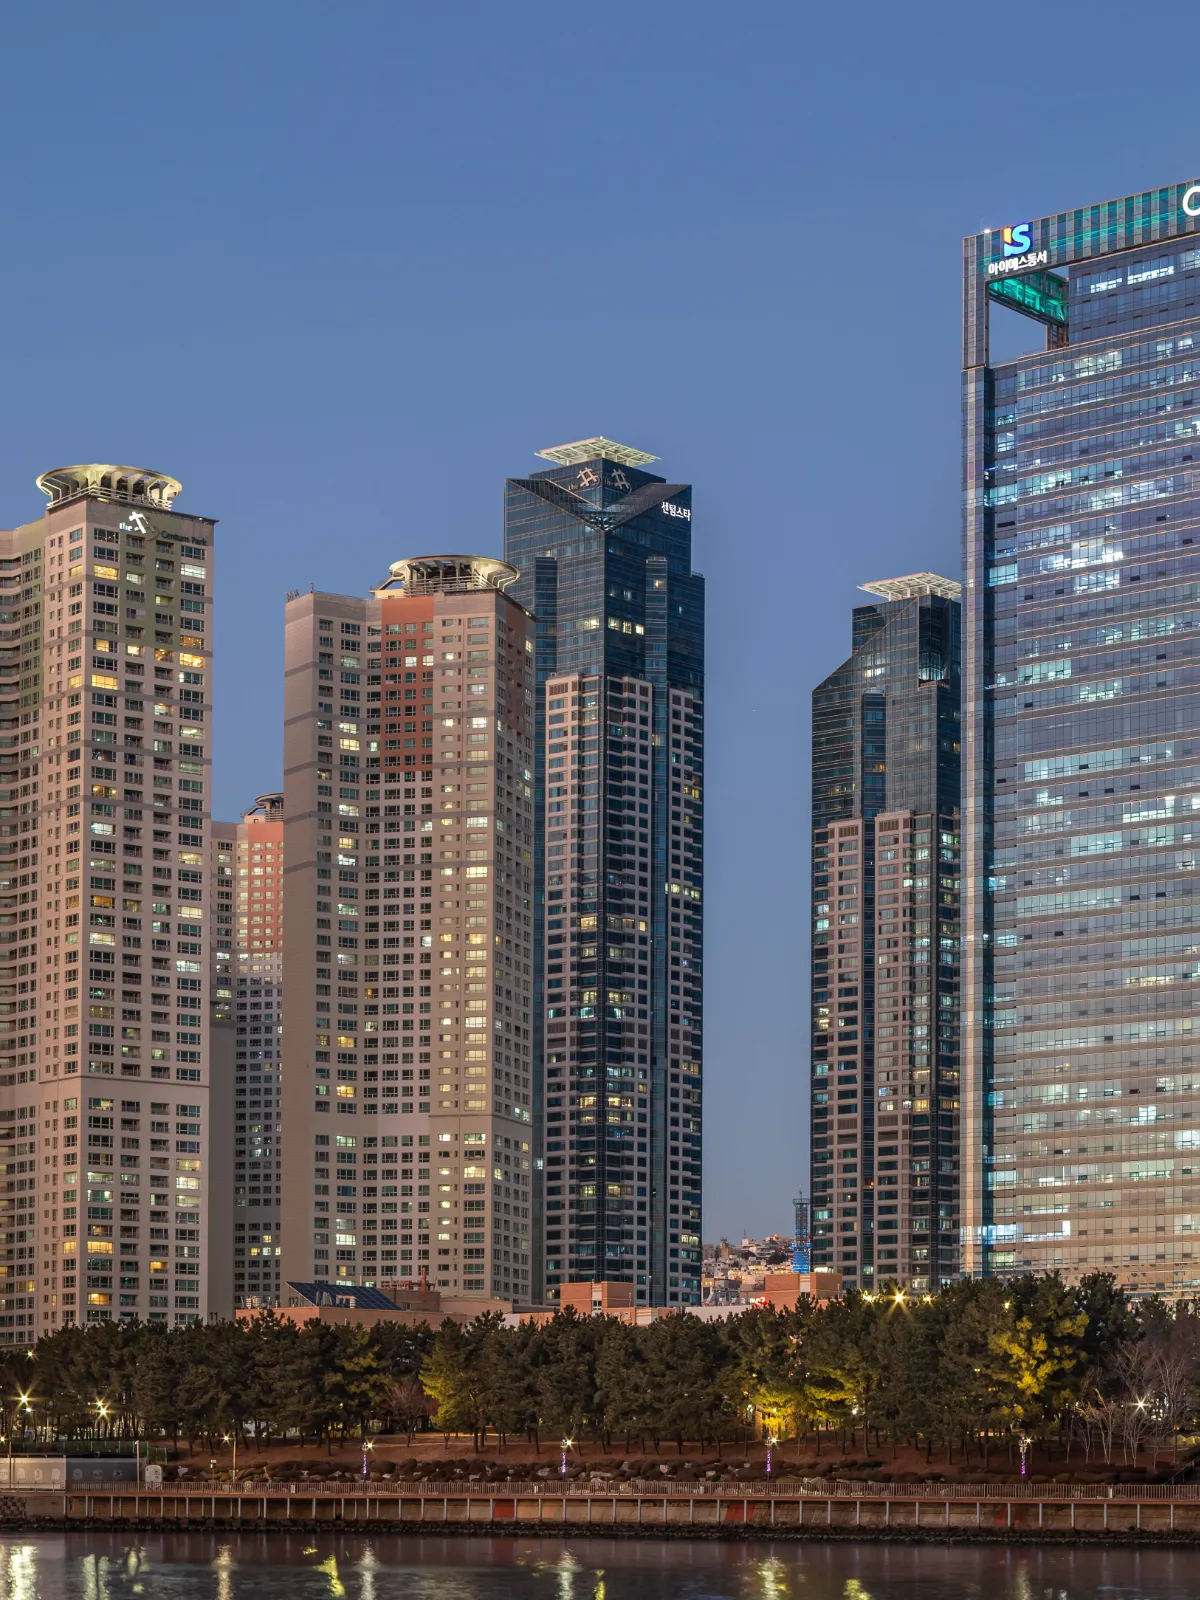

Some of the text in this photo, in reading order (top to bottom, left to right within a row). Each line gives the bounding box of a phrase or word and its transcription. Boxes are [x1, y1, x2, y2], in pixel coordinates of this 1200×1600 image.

[988, 250, 1047, 275] 아이에스동서
[161, 530, 207, 546] Centum Park
